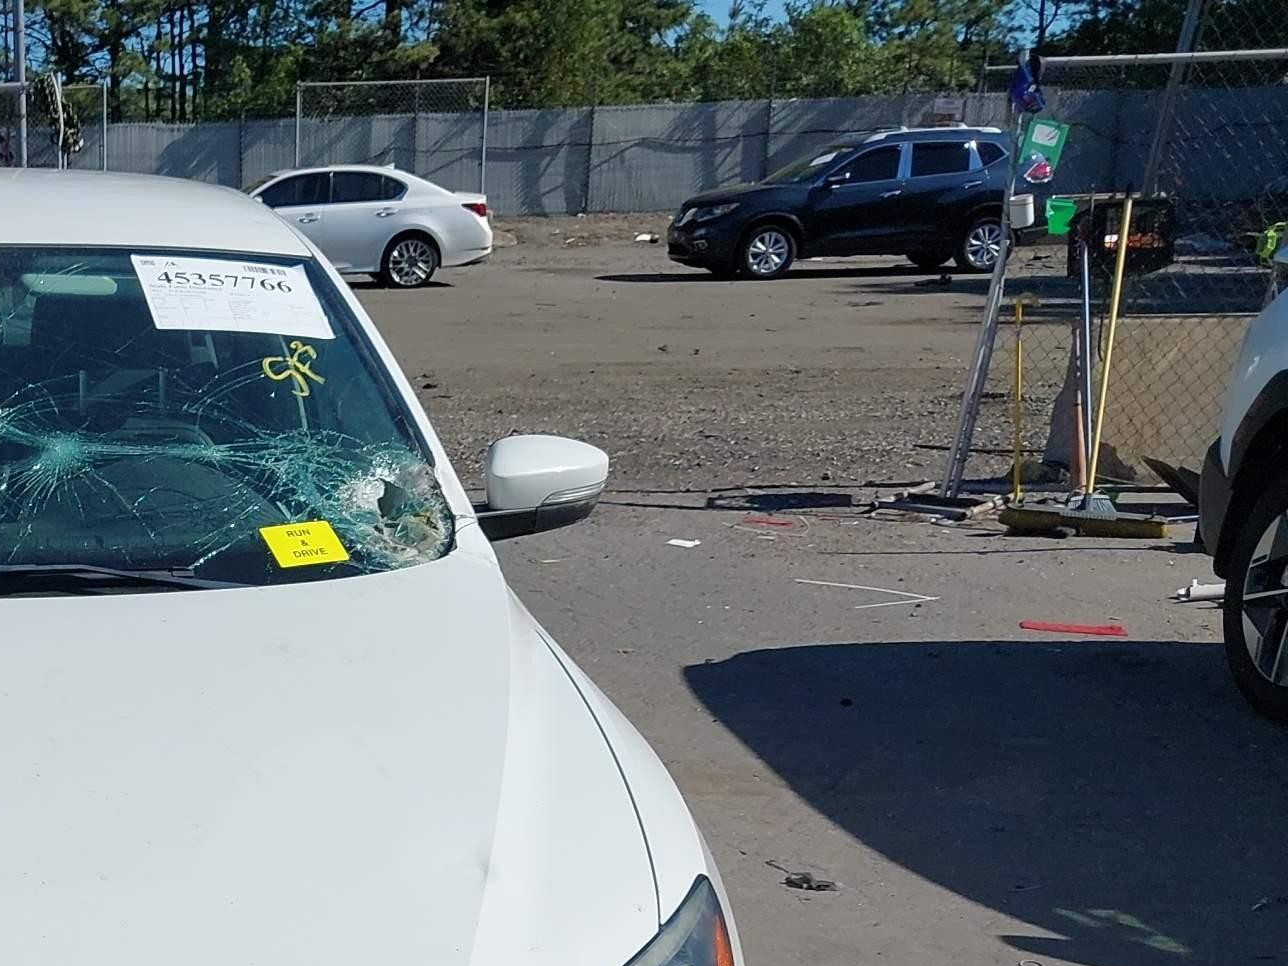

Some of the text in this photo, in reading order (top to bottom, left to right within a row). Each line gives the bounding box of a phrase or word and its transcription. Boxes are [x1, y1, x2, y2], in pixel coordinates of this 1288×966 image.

[157, 271, 292, 294] 45357766
[286, 528, 311, 538] RUN
[300, 539, 309, 547] &
[293, 547, 328, 559] DRIVE
